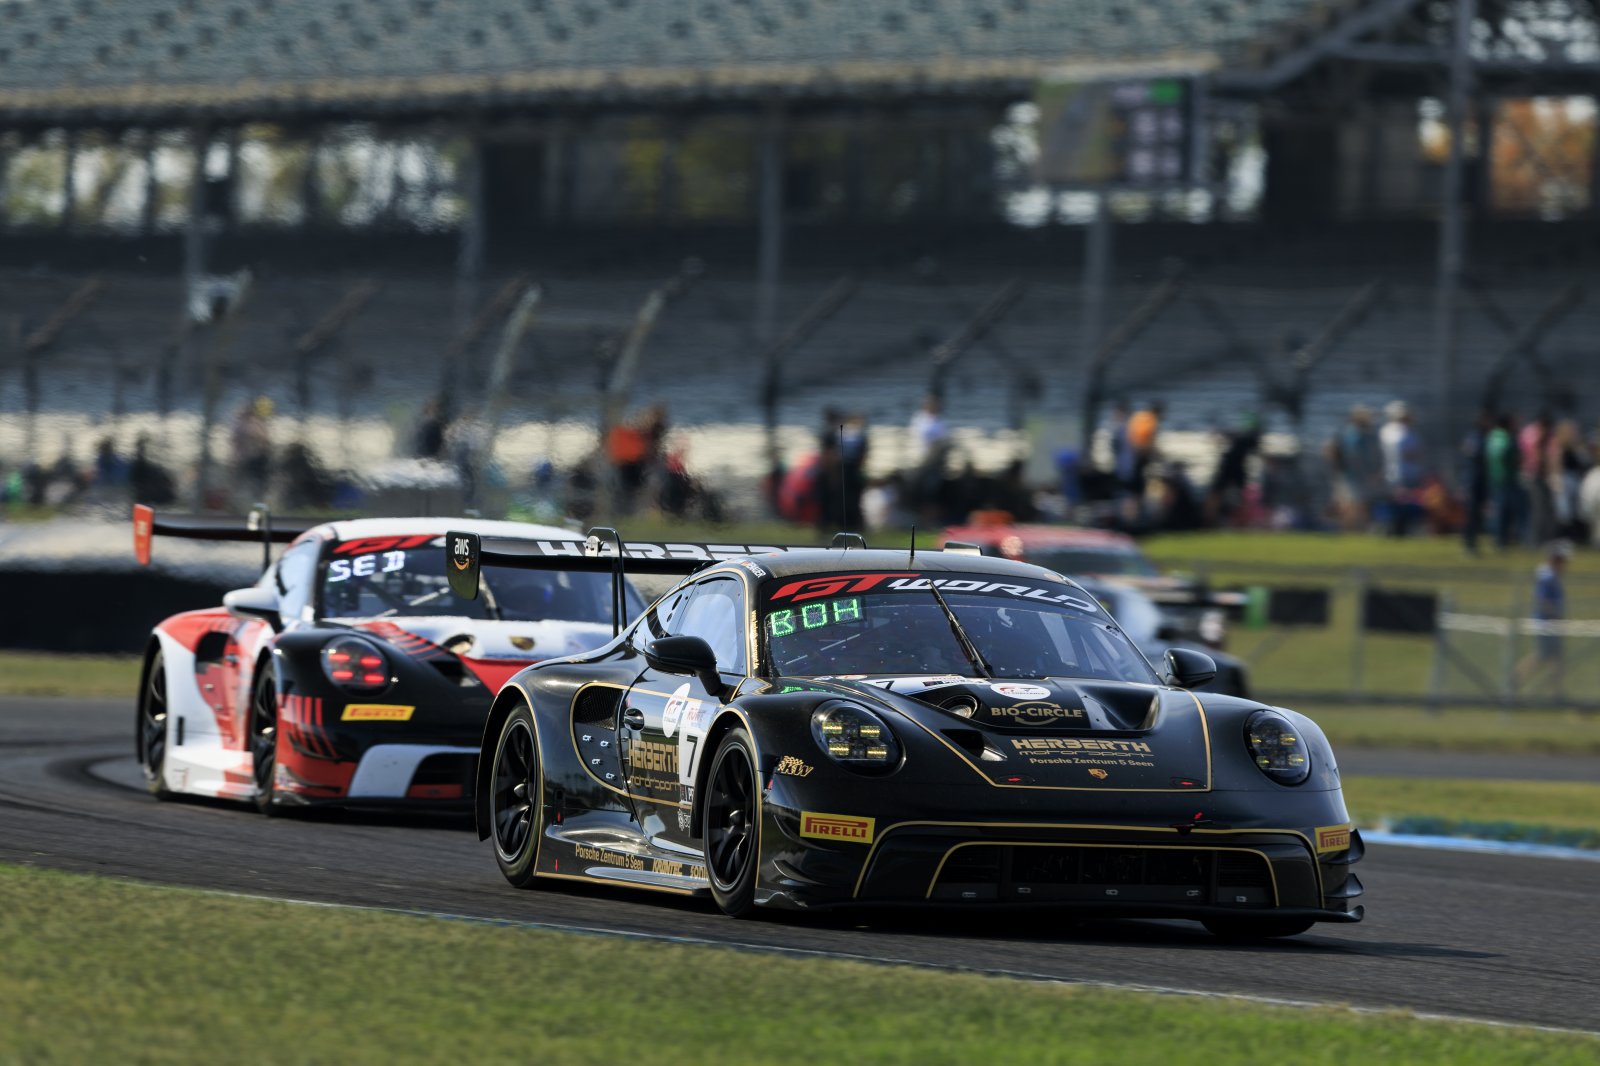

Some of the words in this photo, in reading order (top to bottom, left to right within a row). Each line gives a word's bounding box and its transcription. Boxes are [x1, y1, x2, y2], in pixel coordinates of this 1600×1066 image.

[455, 538, 470, 556] aws
[770, 573, 921, 602] GT
[887, 578, 1098, 613] WORLD
[770, 598, 859, 637] ROH
[991, 707, 1083, 718] BIO-CIRCLE
[629, 739, 679, 774] HERBERTH
[687, 734, 698, 778] 7
[1010, 738, 1151, 753] HERBERTH
[1074, 757, 1117, 766] Zentrum
[805, 816, 868, 839] PIRELLI
[575, 842, 600, 862] Porsche
[600, 847, 625, 867] Zentrum
